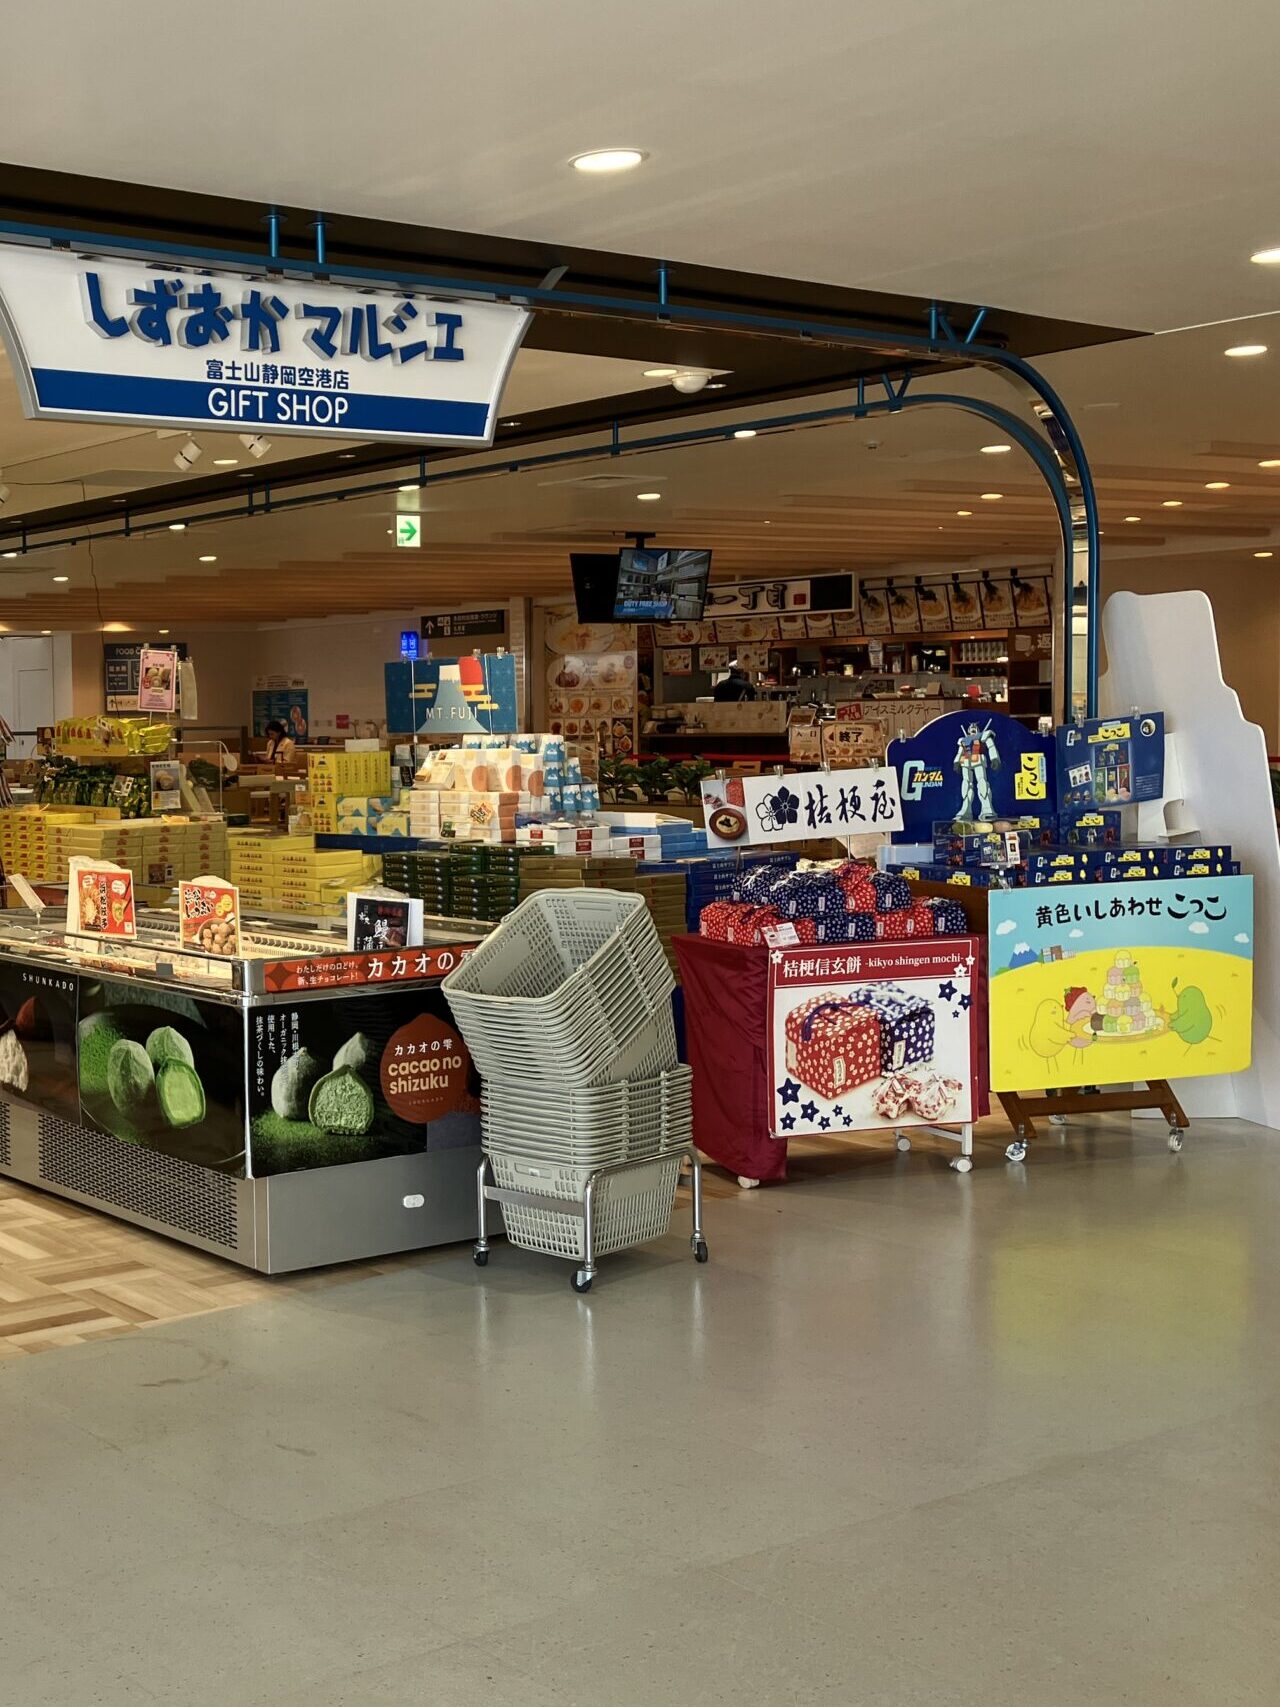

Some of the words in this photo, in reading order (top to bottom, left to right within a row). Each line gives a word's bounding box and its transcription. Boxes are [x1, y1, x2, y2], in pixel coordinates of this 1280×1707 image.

[206, 359, 349, 390] 富士山静岡空港店
[207, 387, 269, 418] GIFT
[277, 393, 349, 424] SHOP
[864, 703, 941, 716] アイスミルクティー
[913, 770, 944, 782] ガンダム
[804, 778, 896, 830] 桔梗屋
[1035, 896, 1163, 929] 黄色いしあわせ
[1167, 893, 1228, 921] こっこ
[783, 956, 862, 979] 桔梗信玄餅
[895, 956, 931, 967] shingen
[22, 972, 74, 992] SHUNKADO
[394, 1038, 453, 1056] カカオの雫
[387, 1060, 440, 1077] cacao
[443, 1054, 462, 1070] no
[389, 1073, 449, 1095] shizuku
